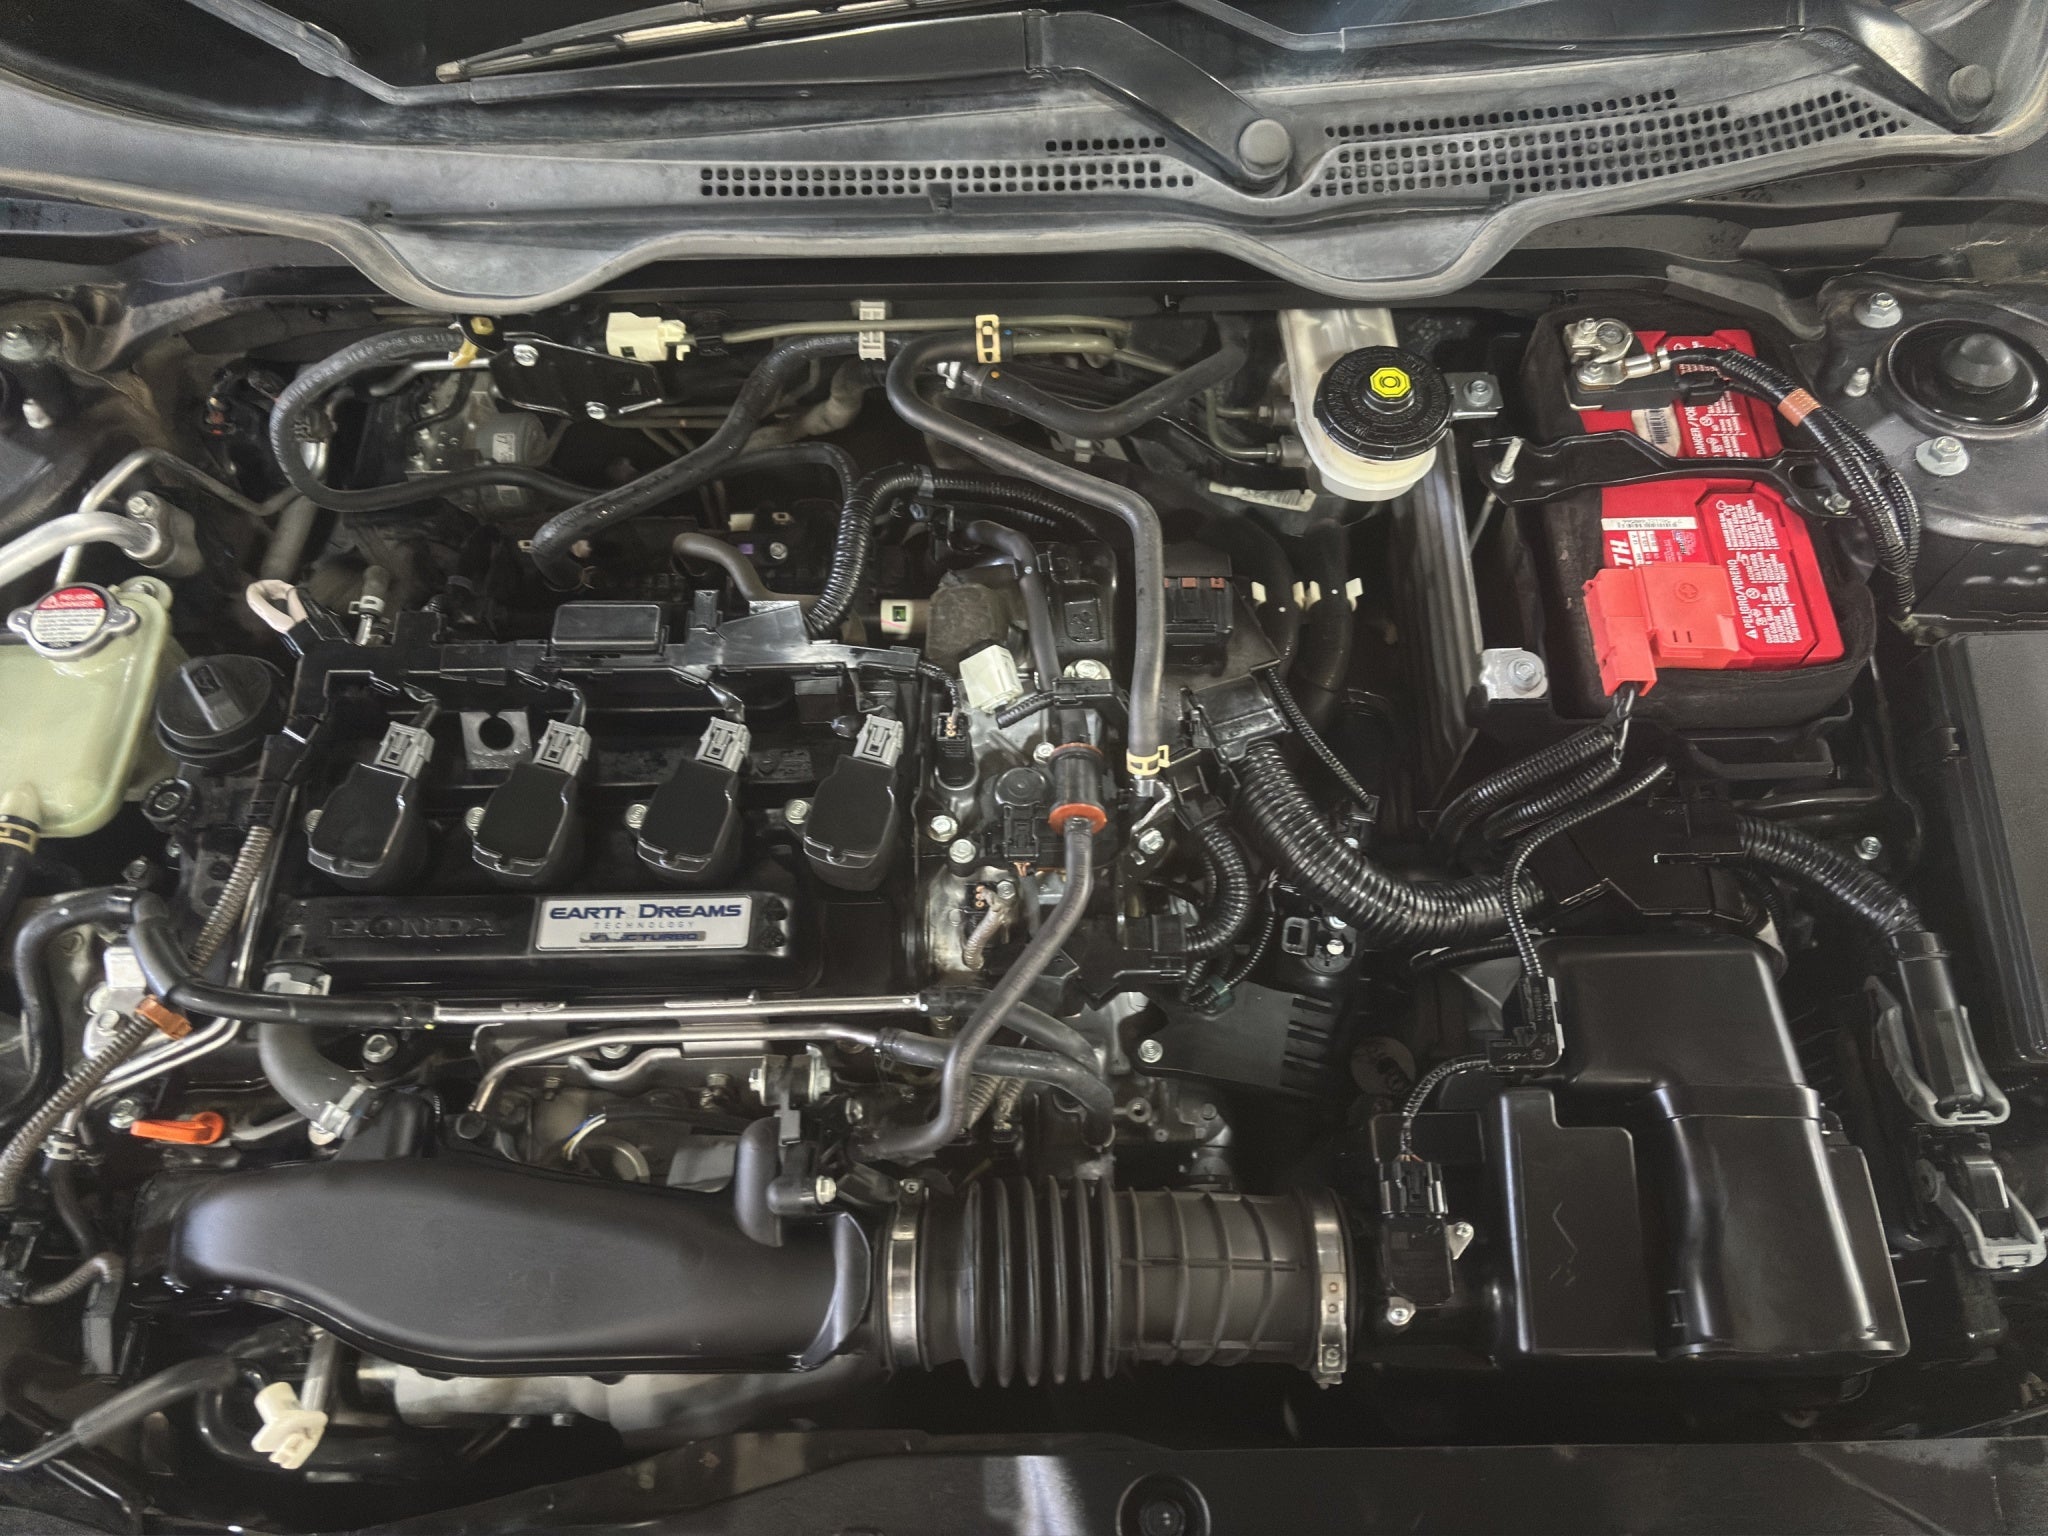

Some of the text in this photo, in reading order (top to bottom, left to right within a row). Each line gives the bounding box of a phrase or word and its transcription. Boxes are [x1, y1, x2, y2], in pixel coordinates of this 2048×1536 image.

[638, 903, 742, 918] DREAMS
[328, 917, 504, 938] HONDA
[592, 920, 695, 929] TECHNOLOGY
[641, 933, 698, 941] TURBO
